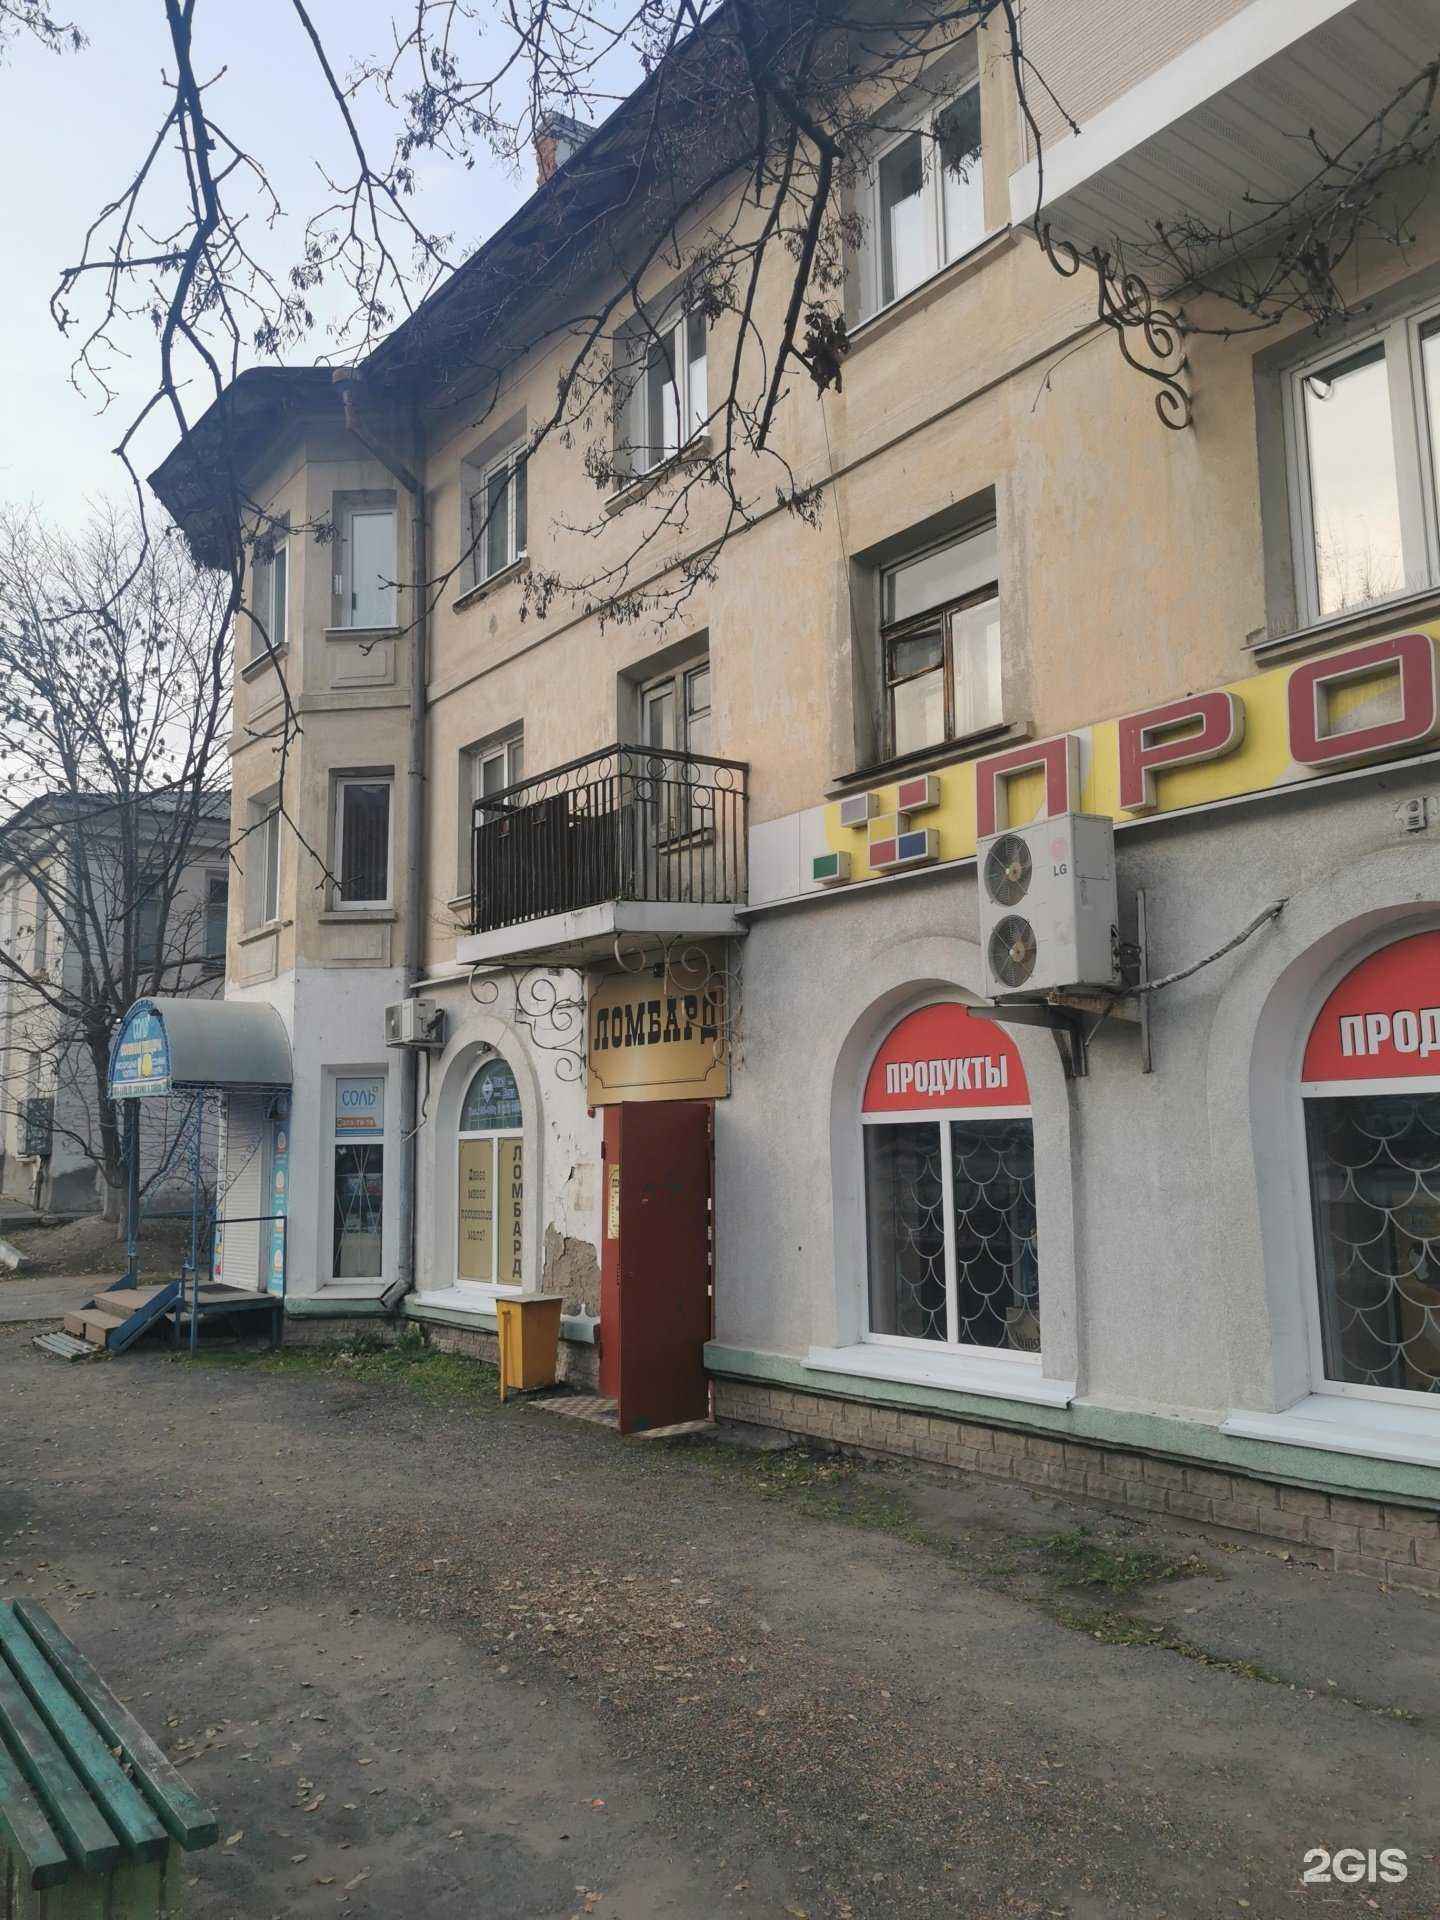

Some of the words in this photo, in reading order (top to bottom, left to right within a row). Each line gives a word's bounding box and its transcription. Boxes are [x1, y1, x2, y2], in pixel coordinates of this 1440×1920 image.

[1053, 863, 1067, 877] LG
[593, 992, 718, 1051] ЛОМБАРД
[885, 1054, 1009, 1097] ПРОДУКТЫ
[342, 1089, 376, 1106] СОЛЬ
[512, 1145, 523, 1279] ЛОМБАРД
